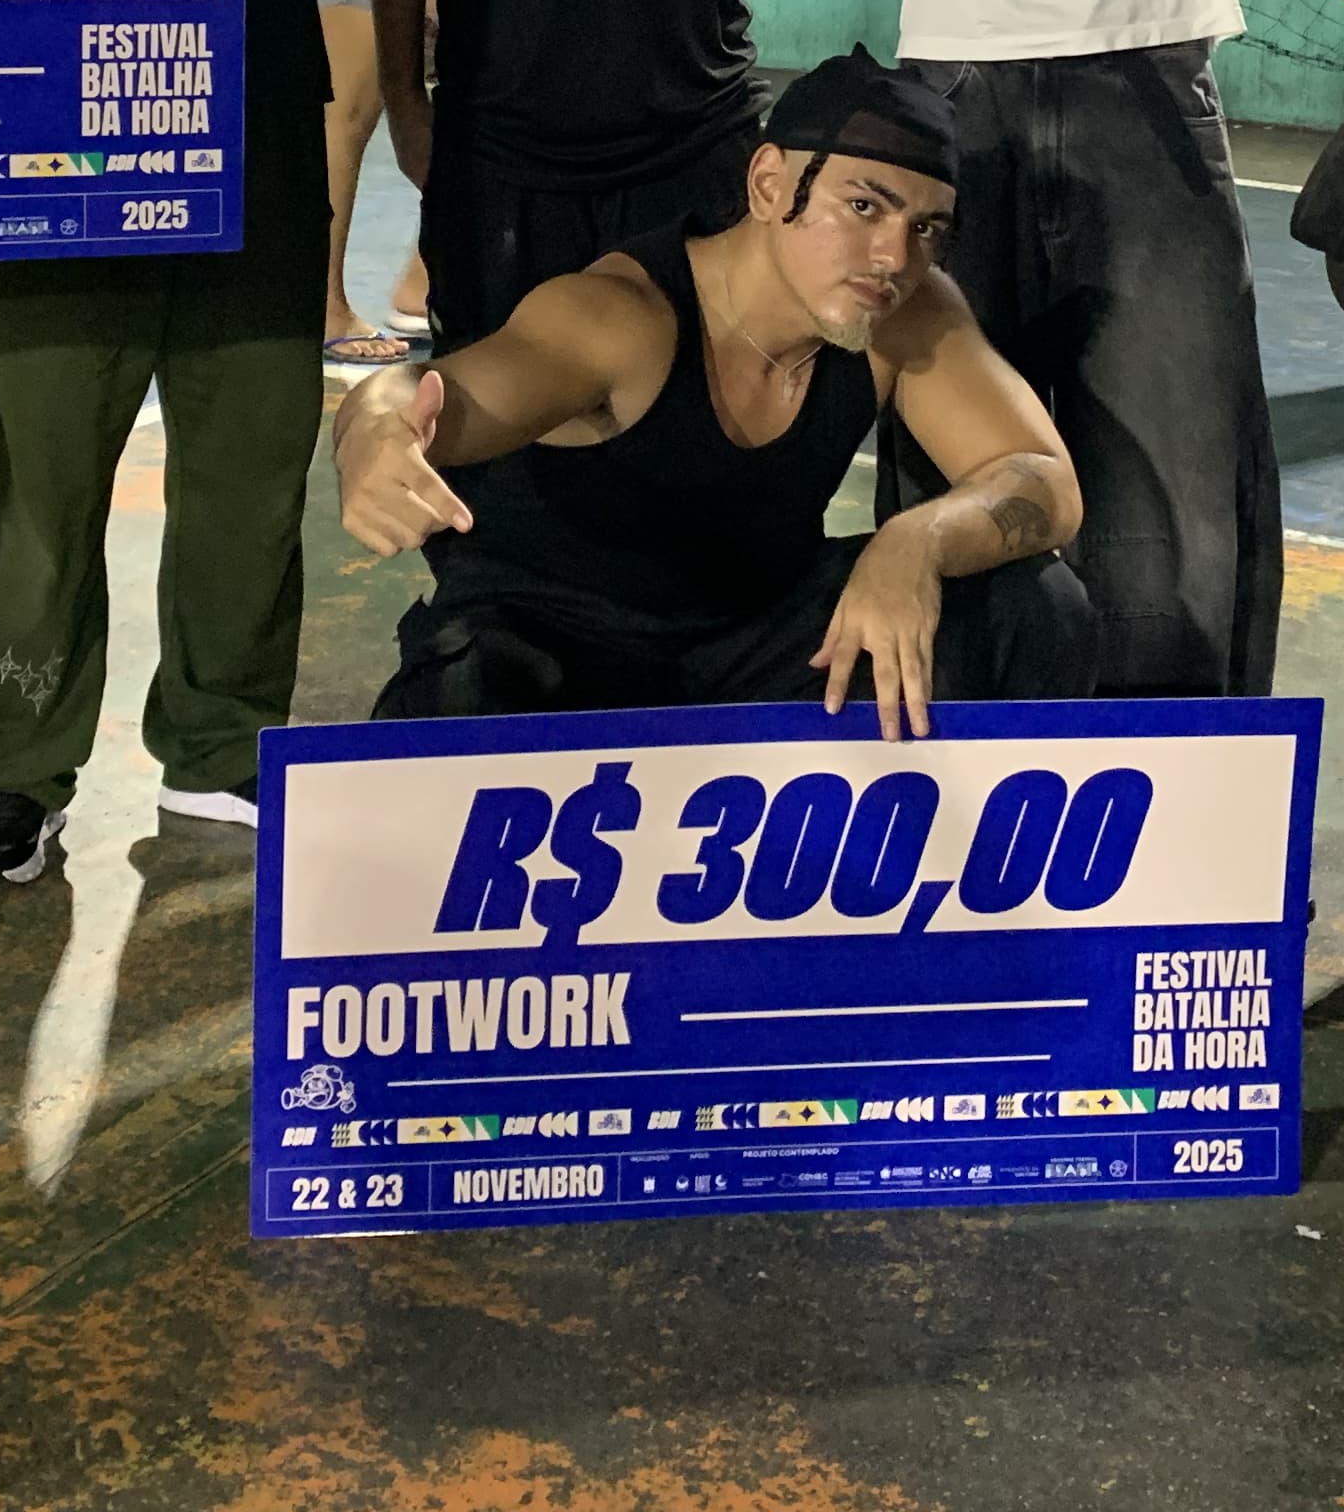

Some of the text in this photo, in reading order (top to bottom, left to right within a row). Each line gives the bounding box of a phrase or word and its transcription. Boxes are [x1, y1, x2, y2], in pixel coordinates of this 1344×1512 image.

[81, 23, 214, 59] FESTIVAL
[81, 61, 213, 98] BATALHA
[81, 98, 210, 137] DA HORA
[121, 199, 189, 232] 2025
[433, 762, 1154, 946] R$ 300,00
[1135, 949, 1273, 990] FESTIVAL
[287, 972, 632, 1060] FOOTWORK
[1134, 989, 1271, 1031] BATALHA
[1133, 1030, 1267, 1073] DA HORA
[742, 1147, 840, 1159] PROJETO CONTEMPLADO
[1172, 1140, 1245, 1175] 2025
[292, 1174, 404, 1211] 22 & 23
[453, 1164, 604, 1204] NOVEMBRO
